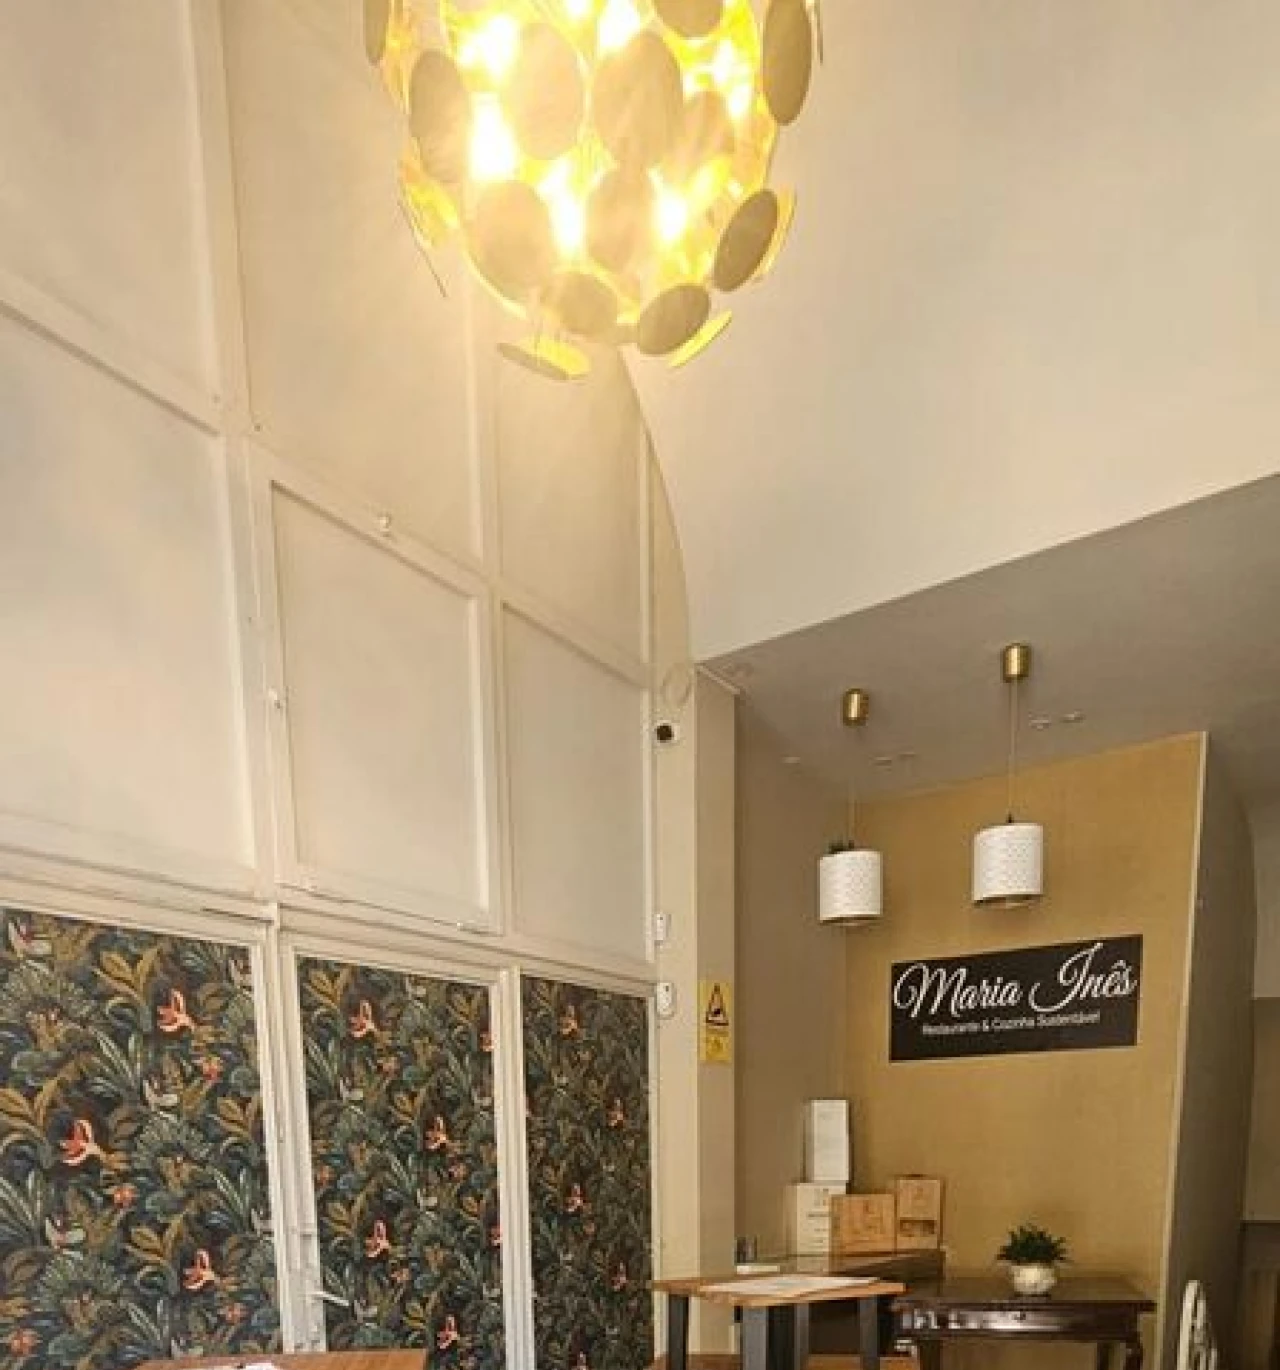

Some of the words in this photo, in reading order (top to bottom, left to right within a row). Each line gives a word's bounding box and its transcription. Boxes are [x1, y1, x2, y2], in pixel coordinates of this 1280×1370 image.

[894, 963, 1023, 1018] Maria
[1028, 942, 1137, 1012] Inês
[922, 1021, 981, 1035] Restaurante
[982, 1018, 989, 1032] &
[991, 1015, 1034, 1030] Cozinha
